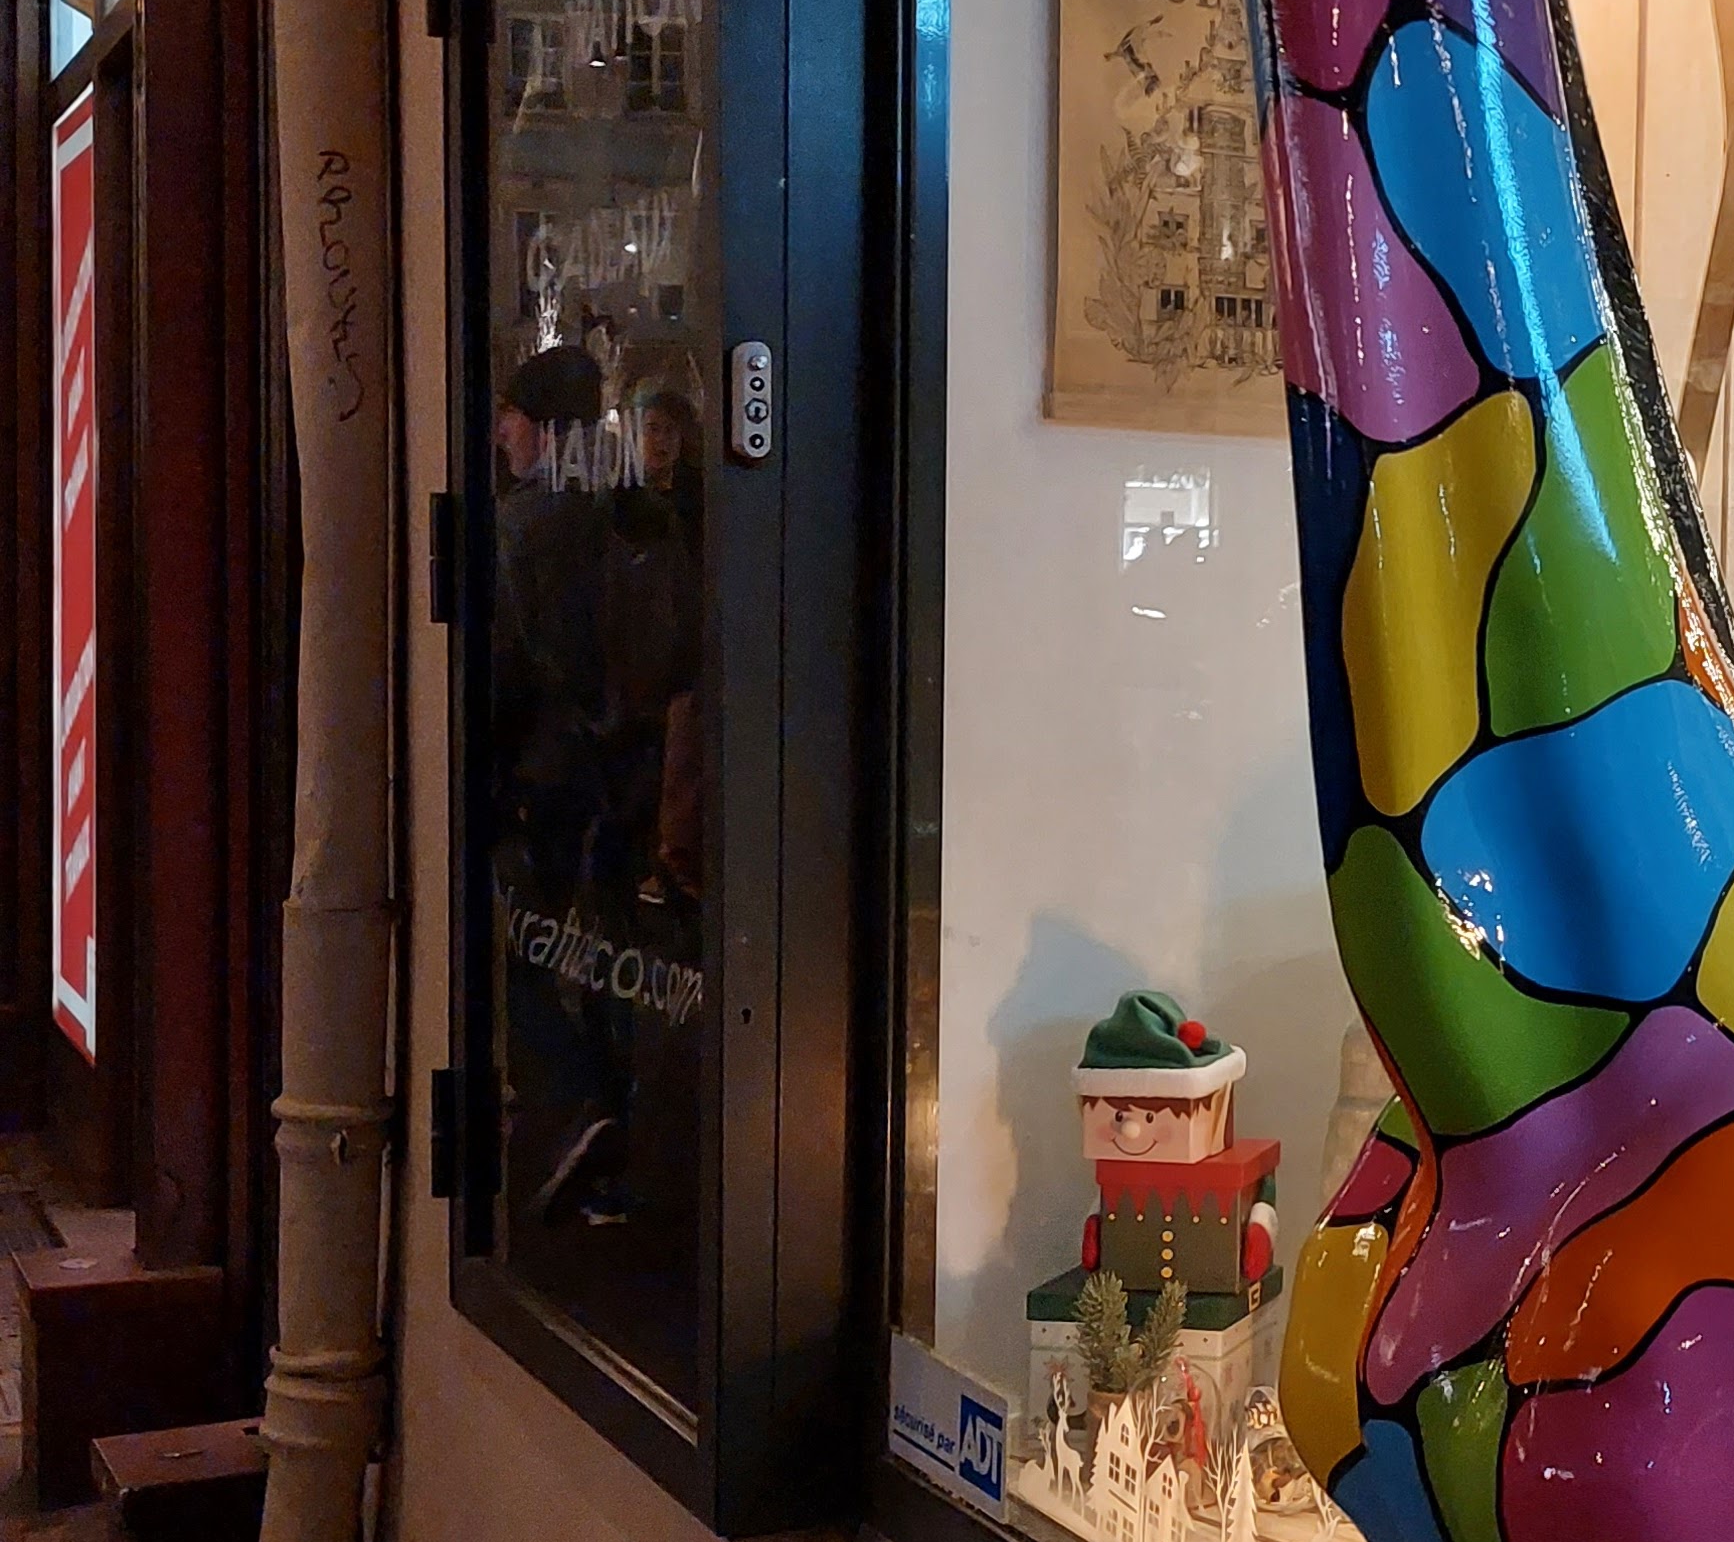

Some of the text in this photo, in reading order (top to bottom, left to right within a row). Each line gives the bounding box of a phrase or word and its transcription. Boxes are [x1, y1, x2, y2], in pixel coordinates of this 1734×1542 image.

[893, 1404, 956, 1457] sécurisé par
[959, 1413, 1002, 1485] ADT
